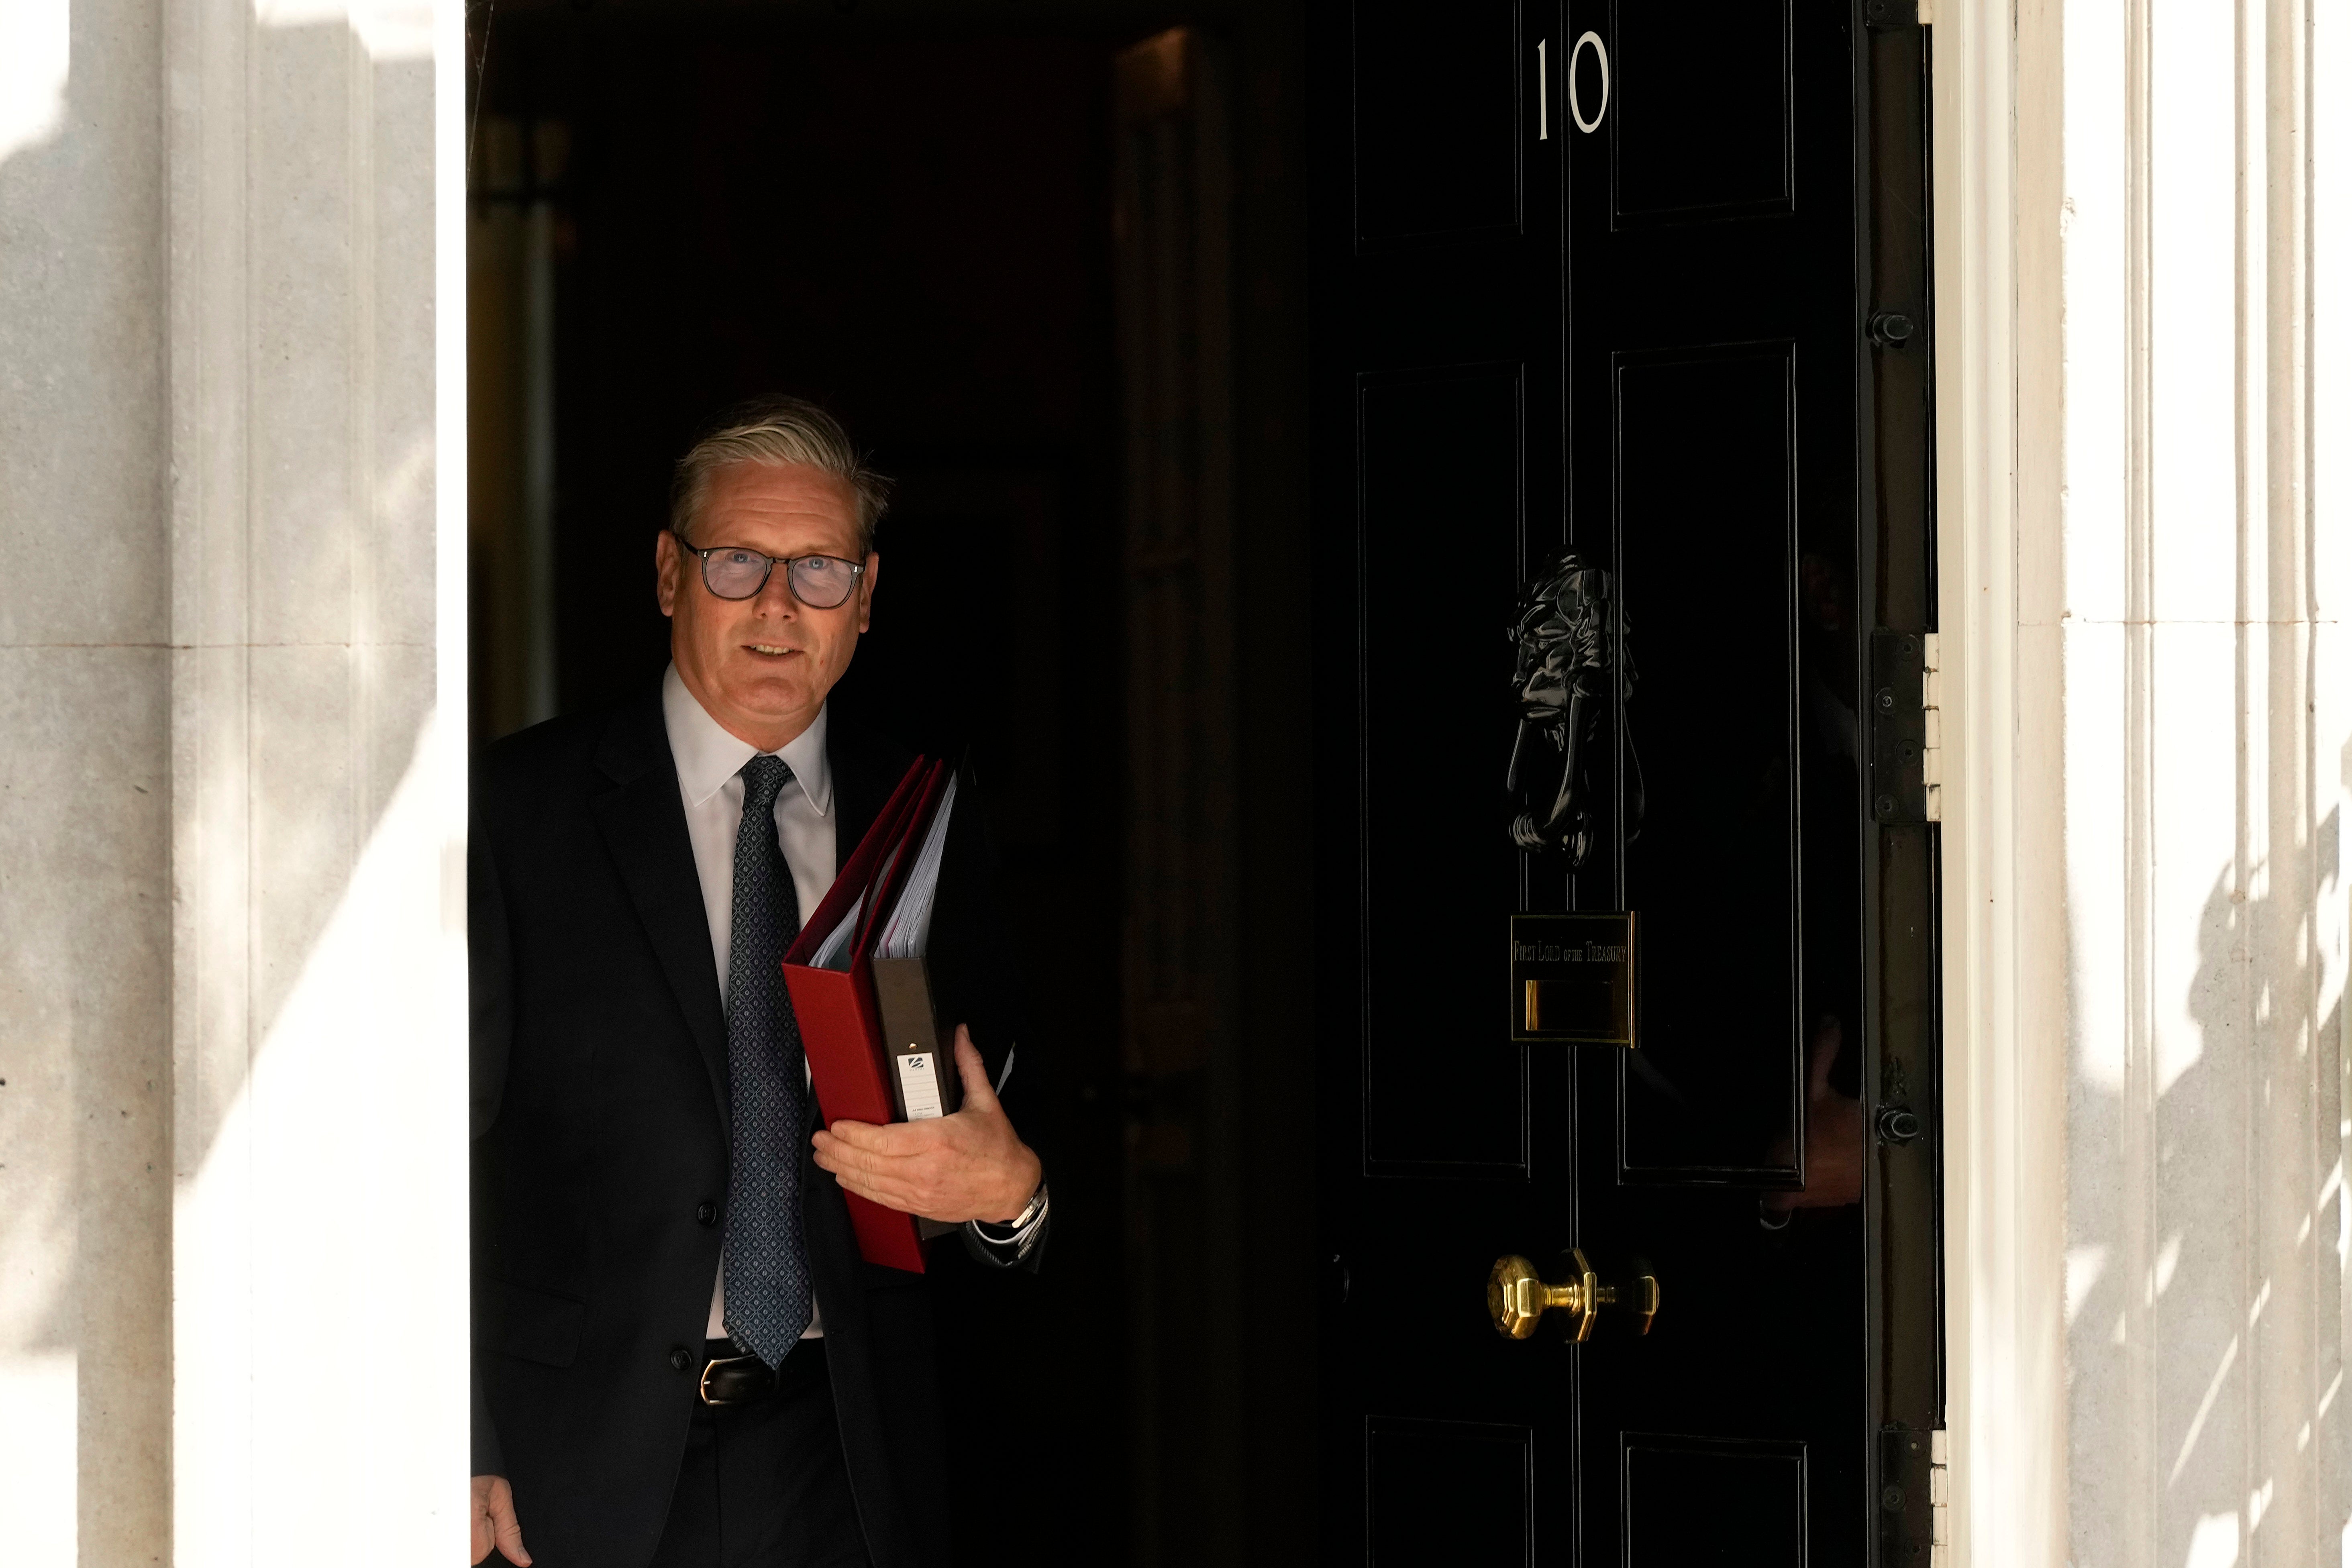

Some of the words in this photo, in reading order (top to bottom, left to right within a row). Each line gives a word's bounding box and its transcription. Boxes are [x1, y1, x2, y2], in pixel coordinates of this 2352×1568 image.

[1537, 31, 1609, 140] 10
[1514, 940, 1536, 962] FIRST
[1538, 940, 1560, 962] LORD
[1586, 940, 1627, 962] TREASURY
